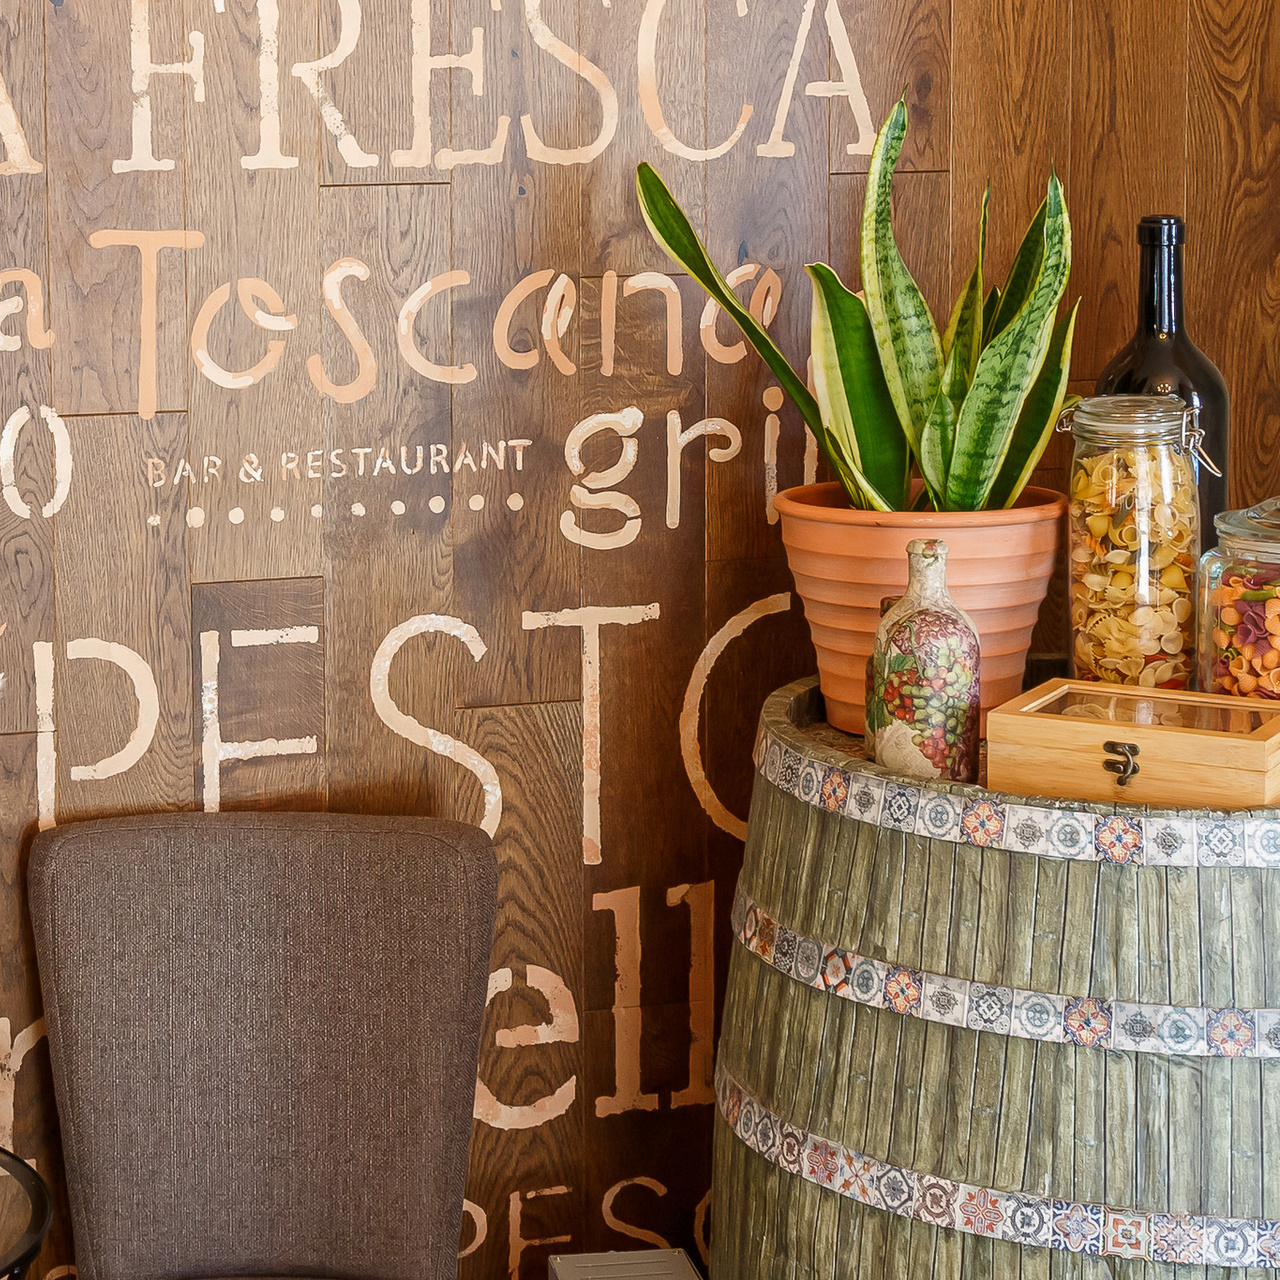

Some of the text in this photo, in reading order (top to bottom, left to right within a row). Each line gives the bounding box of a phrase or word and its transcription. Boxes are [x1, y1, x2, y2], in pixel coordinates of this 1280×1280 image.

[88, 229, 782, 420] Toscana
[147, 439, 532, 487] BAR & RESTAURANT
